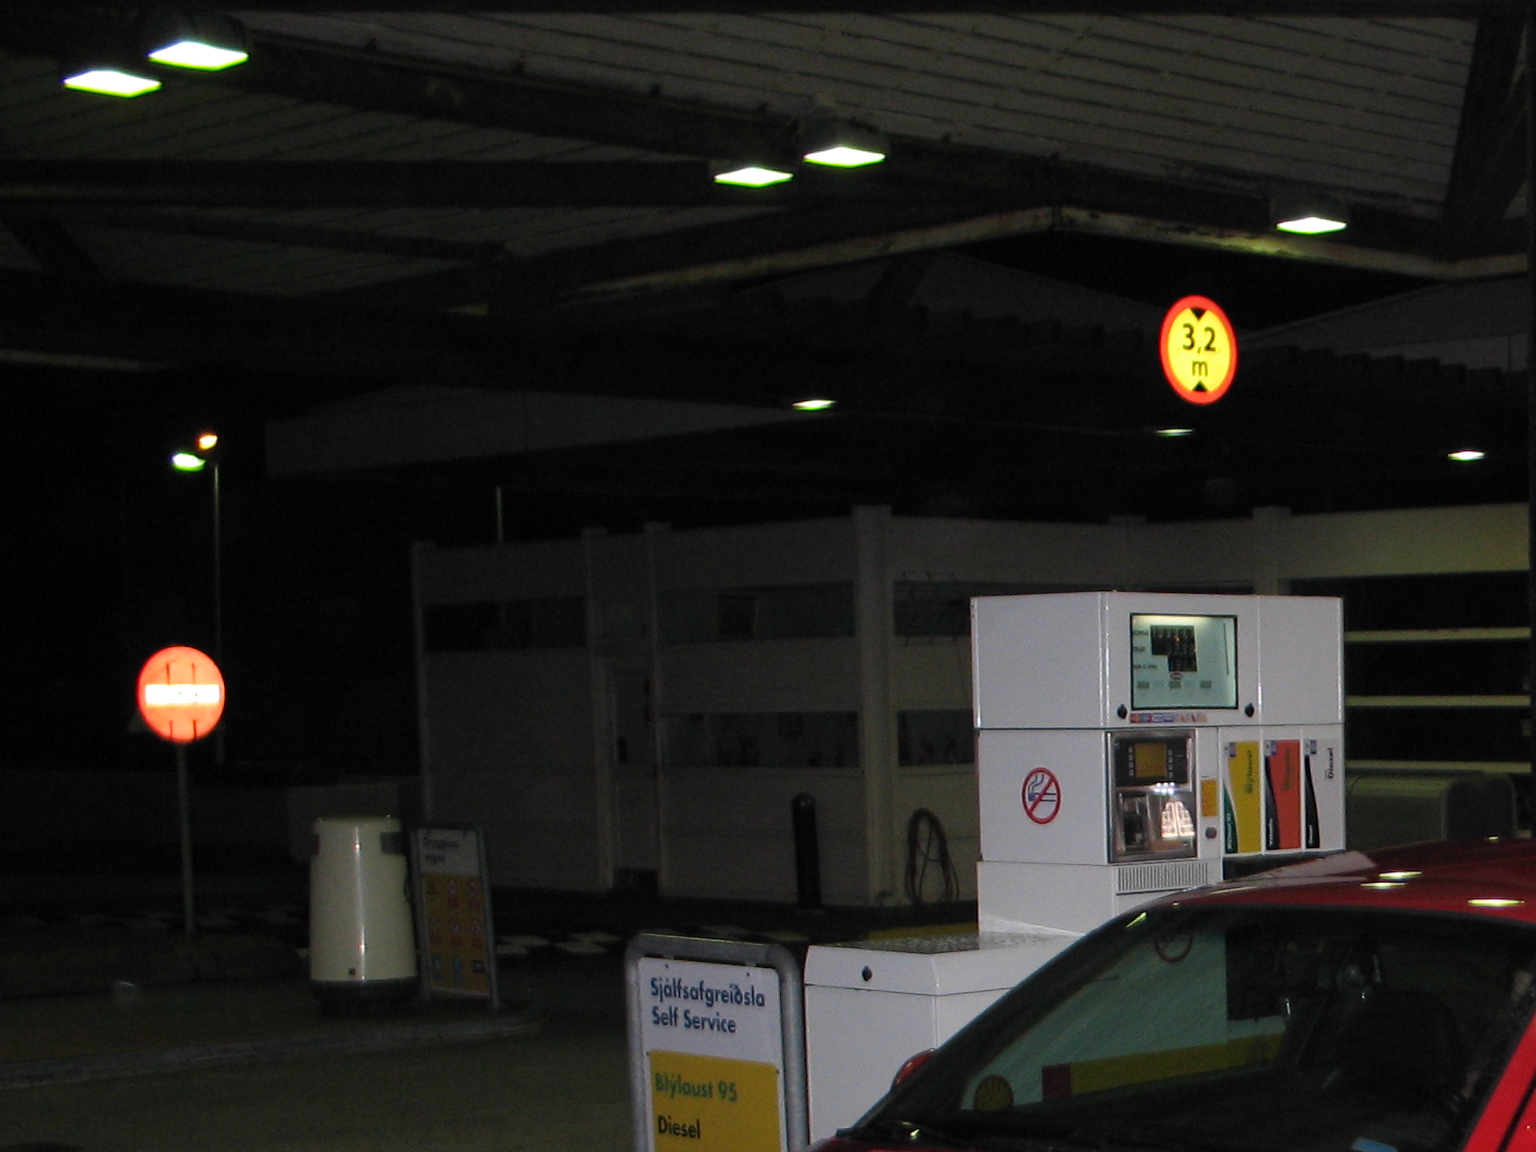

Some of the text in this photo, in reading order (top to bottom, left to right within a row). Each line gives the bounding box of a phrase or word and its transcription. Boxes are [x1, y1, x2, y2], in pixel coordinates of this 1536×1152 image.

[1182, 322, 1216, 354] 3,2
[1192, 359, 1209, 377] m
[650, 977, 766, 1008] Sjálfsafgreiðsla
[652, 1005, 737, 1034] Self Service
[655, 1072, 738, 1102] Blýlaust 95
[657, 1114, 701, 1140] Diesel
